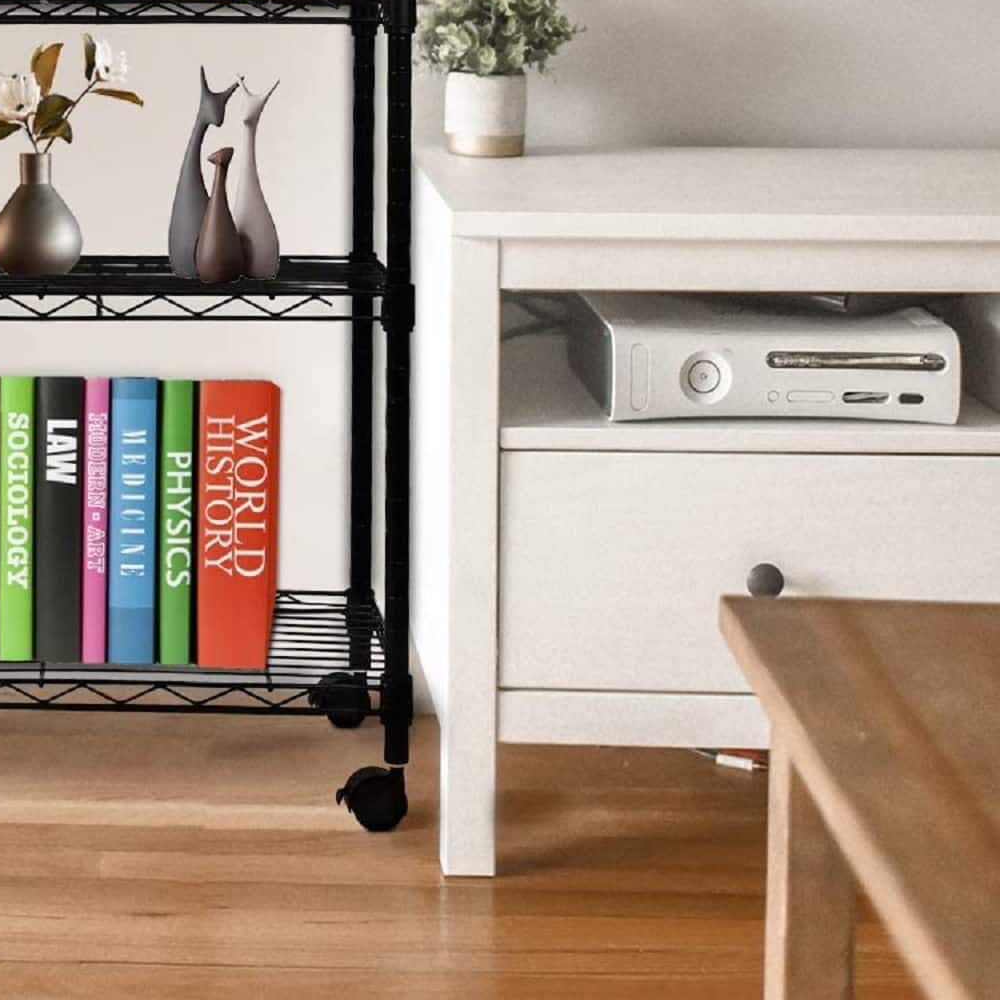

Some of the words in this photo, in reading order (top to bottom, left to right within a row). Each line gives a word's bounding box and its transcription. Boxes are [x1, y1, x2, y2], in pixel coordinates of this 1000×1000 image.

[7, 412, 29, 590] SOCIOLOGY
[46, 419, 78, 485] LAW
[88, 413, 108, 508] MODERN
[120, 429, 147, 577] MEDICINE
[166, 452, 192, 588] PHYSICS
[205, 415, 235, 576] HISTORY
[234, 414, 268, 577] WORLD
[88, 526, 105, 573] ART
